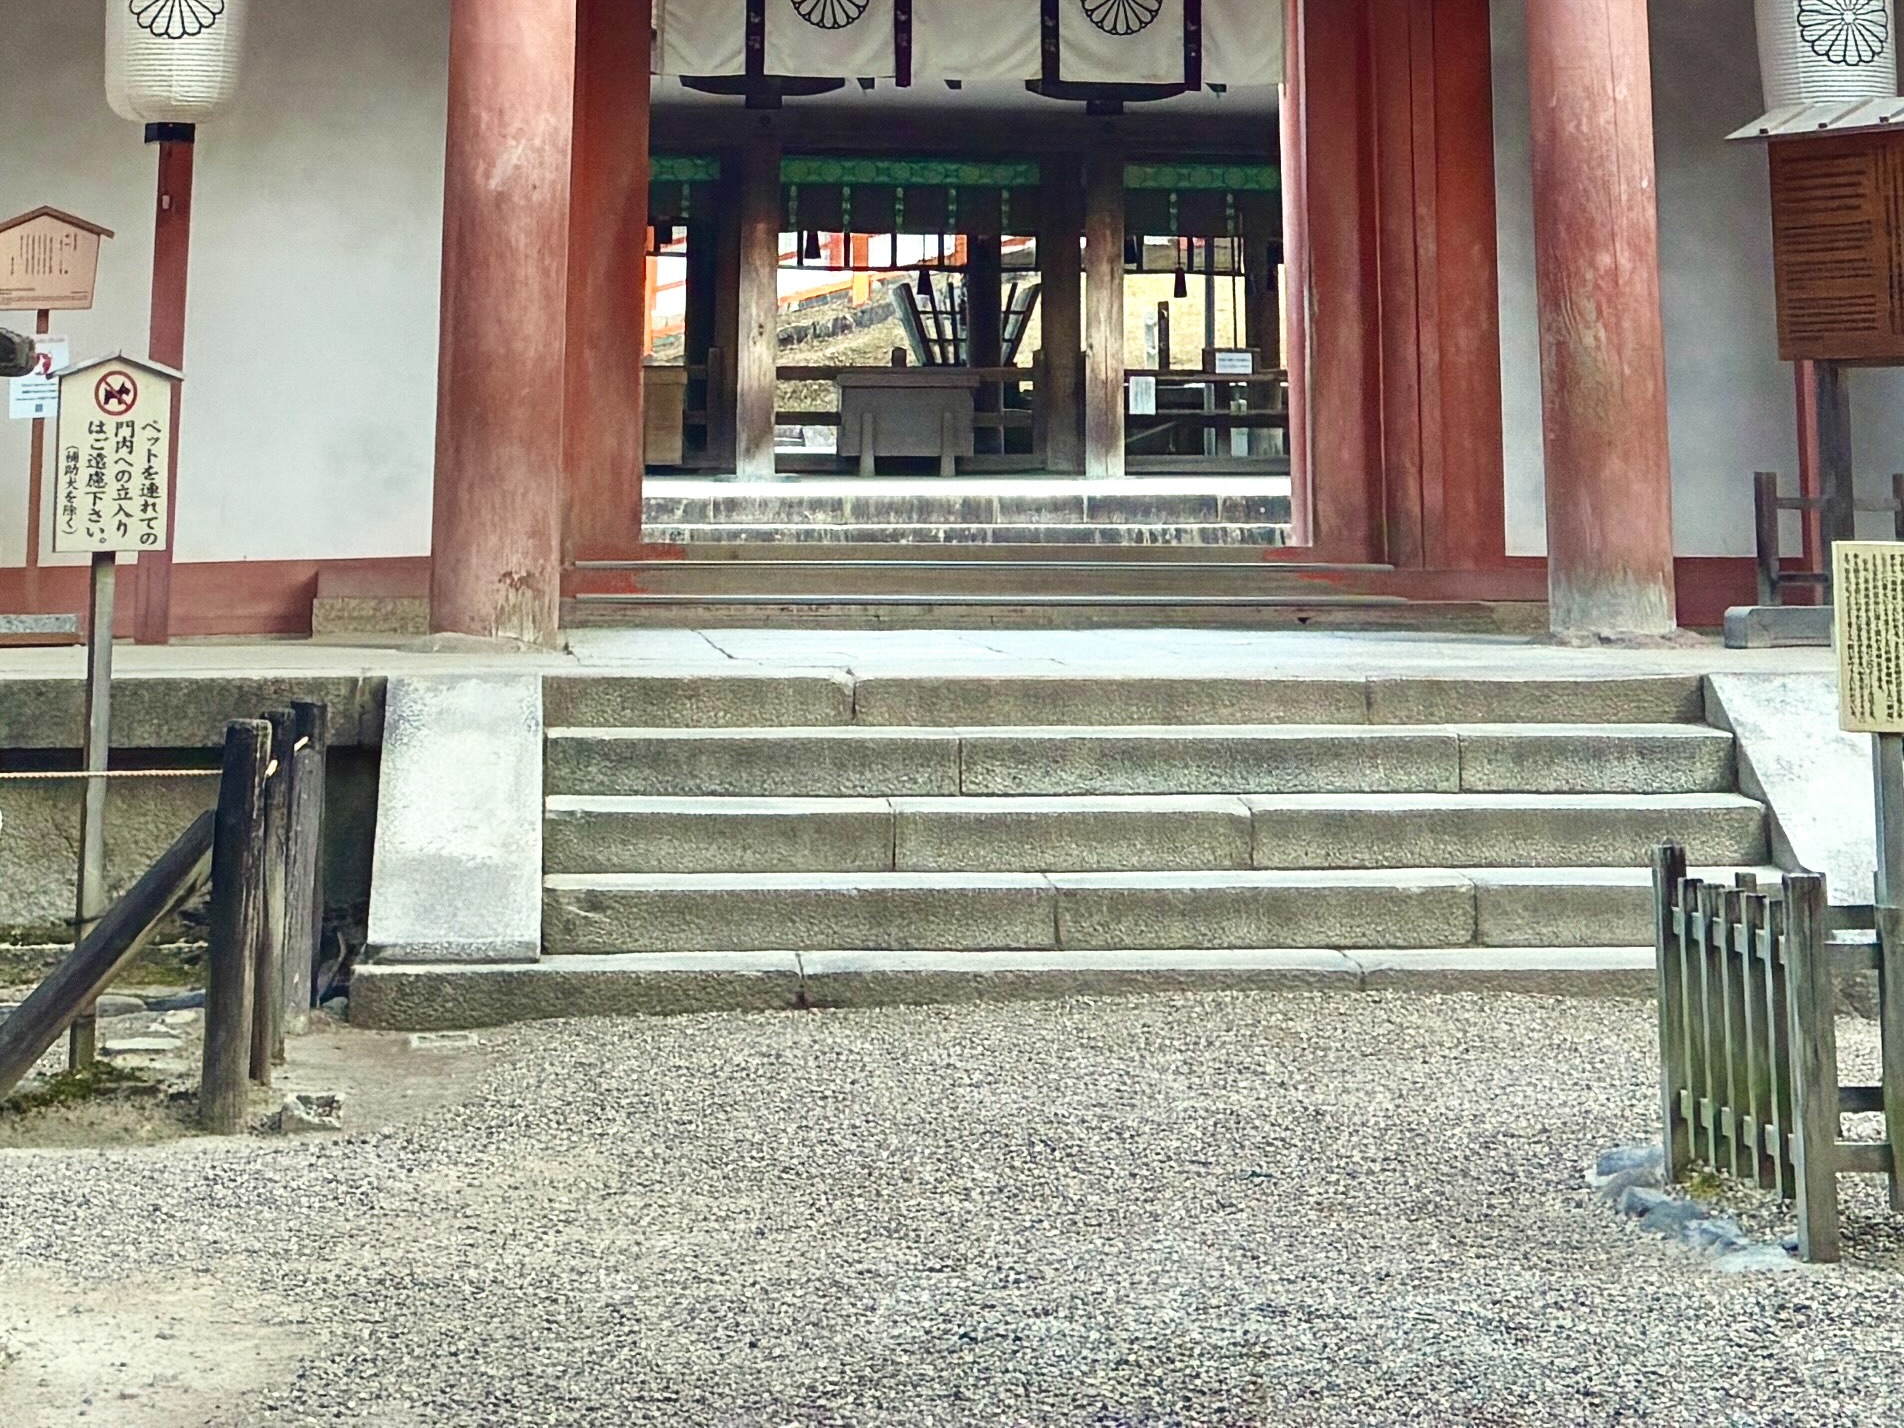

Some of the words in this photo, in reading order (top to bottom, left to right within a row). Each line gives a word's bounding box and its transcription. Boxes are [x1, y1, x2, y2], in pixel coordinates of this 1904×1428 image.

[84, 420, 109, 544] はご遠慮下さい。
[112, 420, 135, 538] 門内への立入り
[138, 419, 162, 545] ペットを連れての
